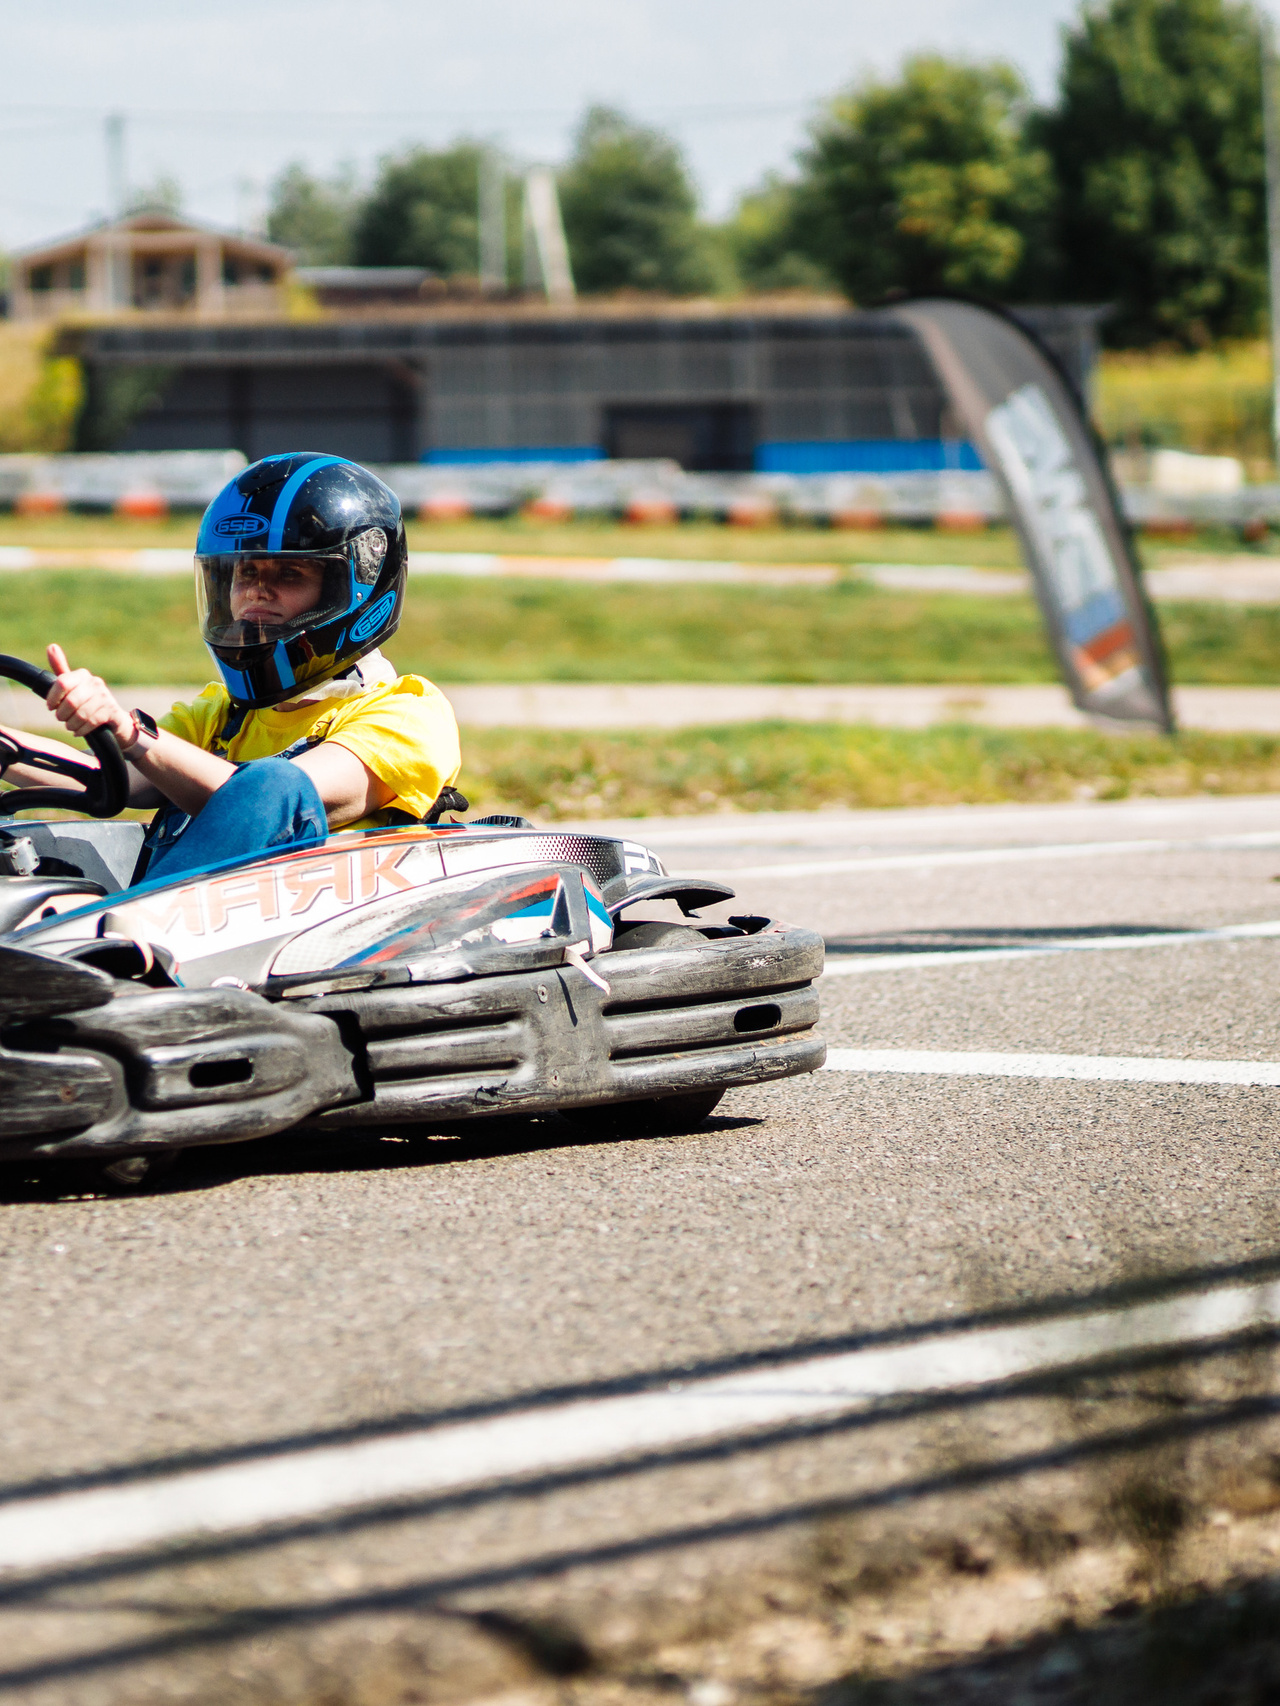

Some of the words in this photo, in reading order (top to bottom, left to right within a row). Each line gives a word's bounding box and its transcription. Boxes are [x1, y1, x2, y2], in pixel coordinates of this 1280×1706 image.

[216, 518, 260, 533] GSB
[357, 600, 393, 636] GSB
[128, 846, 414, 937] МАЯК
